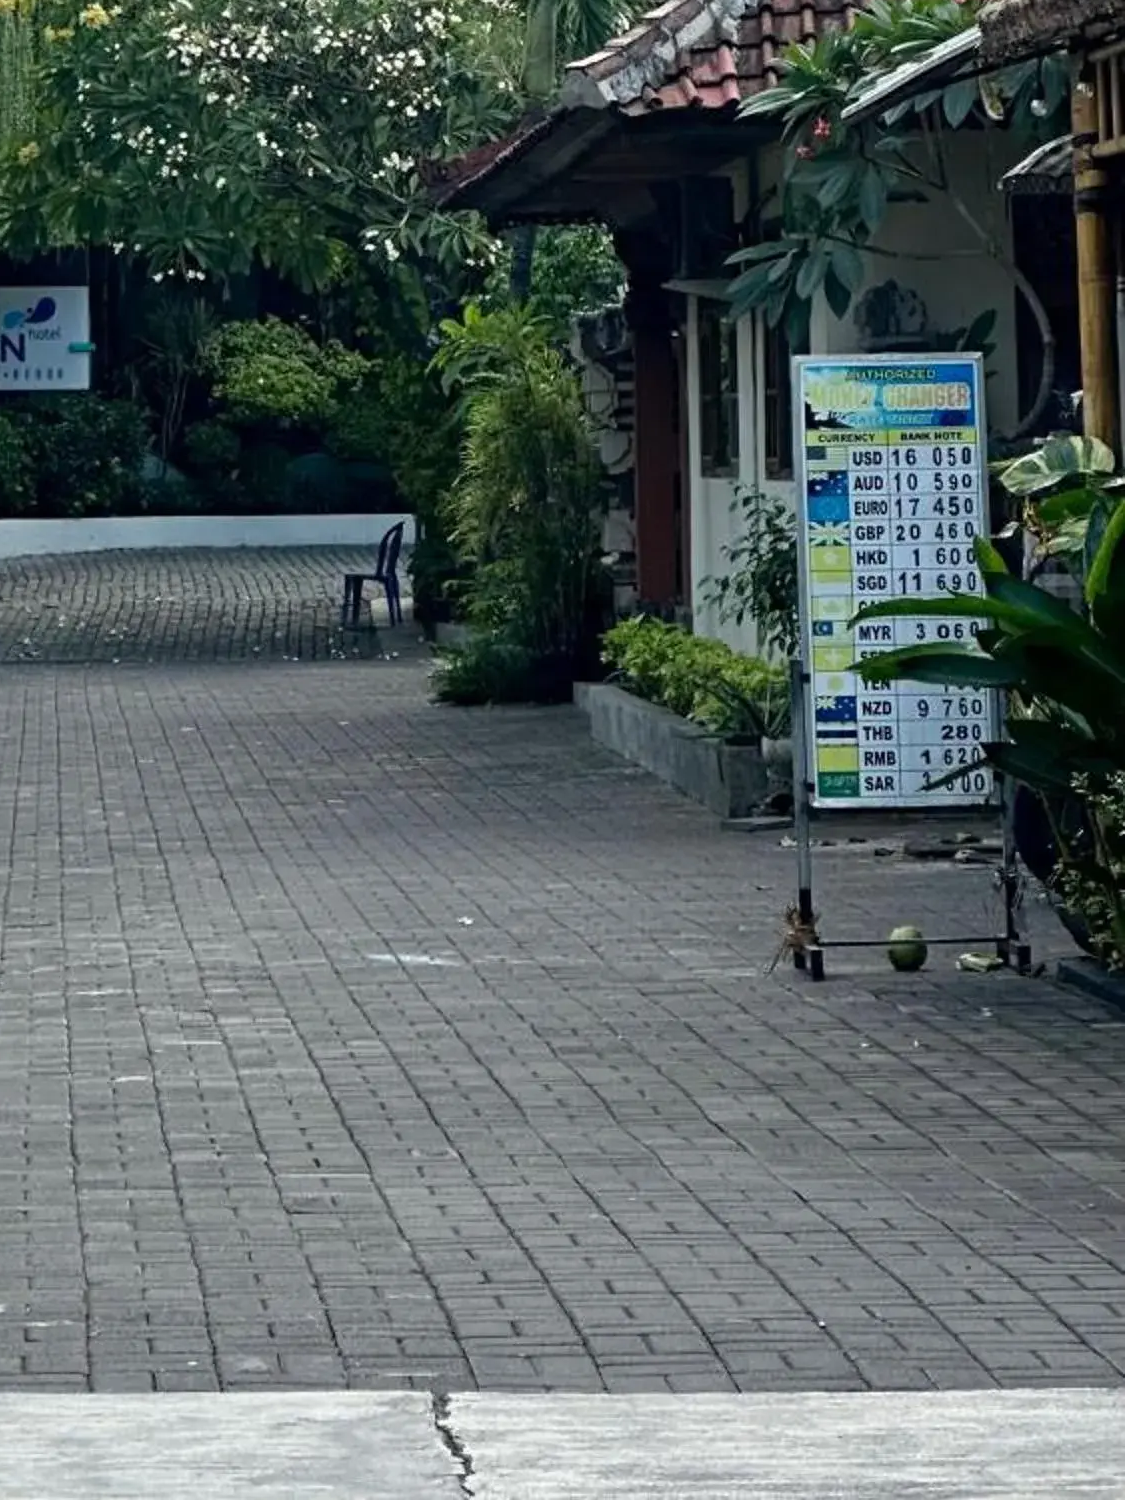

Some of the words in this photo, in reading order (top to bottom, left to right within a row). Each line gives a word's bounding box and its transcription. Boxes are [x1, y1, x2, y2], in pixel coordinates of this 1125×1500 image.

[845, 369, 936, 381] AUTHORIZED
[818, 432, 876, 443] CURRENCY
[900, 431, 932, 442] BANK
[934, 431, 964, 441] NOTE
[852, 451, 883, 466] USD
[892, 448, 917, 467] 16
[932, 447, 972, 467] 050
[854, 476, 884, 491] AUD
[894, 472, 918, 493] 10
[934, 472, 973, 491] 590
[854, 501, 888, 516] EURO
[895, 497, 921, 518] 17
[933, 497, 974, 516] 450
[855, 526, 885, 541] GBP
[896, 524, 921, 541] 20
[934, 521, 975, 541] 460
[856, 551, 888, 565] HKD
[912, 548, 921, 567] 1
[936, 547, 976, 565] 600
[857, 575, 888, 591] SGD
[898, 572, 921, 594] 11
[936, 571, 977, 591] 690
[858, 626, 891, 641] MYR
[916, 623, 926, 640] 3
[937, 621, 980, 639] 060
[862, 701, 892, 716] NZD
[917, 699, 929, 718] 9
[943, 697, 983, 717] 760
[863, 726, 893, 741] THB
[941, 724, 982, 741] 280
[864, 751, 896, 766] RMB
[920, 750, 931, 765] 1
[944, 747, 980, 765] 620
[865, 777, 895, 791] SAR
